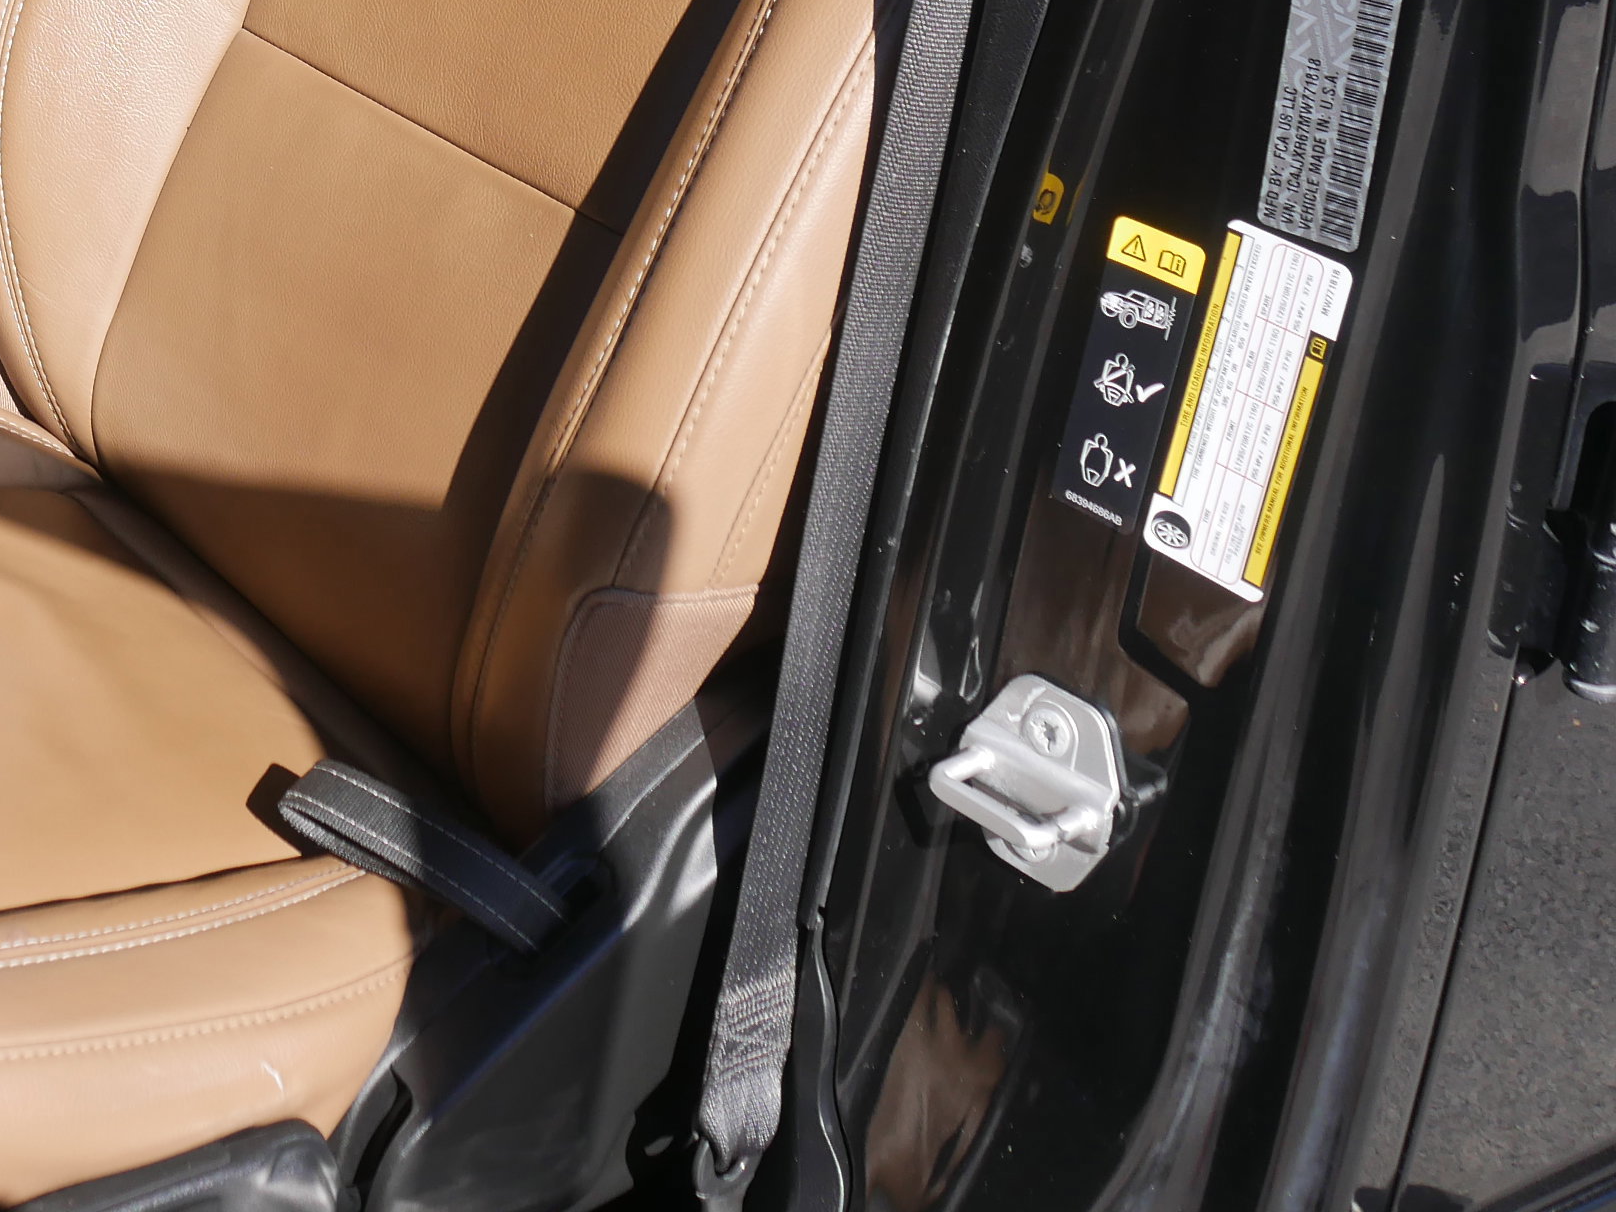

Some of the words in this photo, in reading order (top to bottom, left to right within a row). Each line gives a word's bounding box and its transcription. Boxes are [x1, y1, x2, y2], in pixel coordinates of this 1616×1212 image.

[1281, 84, 1297, 110] LLC
[1319, 67, 1339, 111] U.S.A.
[1277, 111, 1293, 132] US
[1315, 112, 1331, 133] IN:
[1273, 133, 1289, 160] FCA
[1309, 135, 1328, 175] MADE
[1269, 163, 1285, 187] BY:
[1264, 189, 1281, 220] MFD
[1281, 197, 1298, 226] VIN:
[1300, 177, 1321, 233] VEHICLE
[1260, 294, 1271, 316] SPARE
[1321, 268, 1341, 316] MW771818
[1200, 302, 1221, 356] INFORMATION
[1226, 343, 1235, 357] AND
[1190, 356, 1205, 391] LOADING
[1185, 391, 1196, 409] AND
[1180, 409, 1191, 428] TIRE
[1279, 432, 1294, 470] ADDITIONAL
[1290, 385, 1307, 431] INFORMATION
